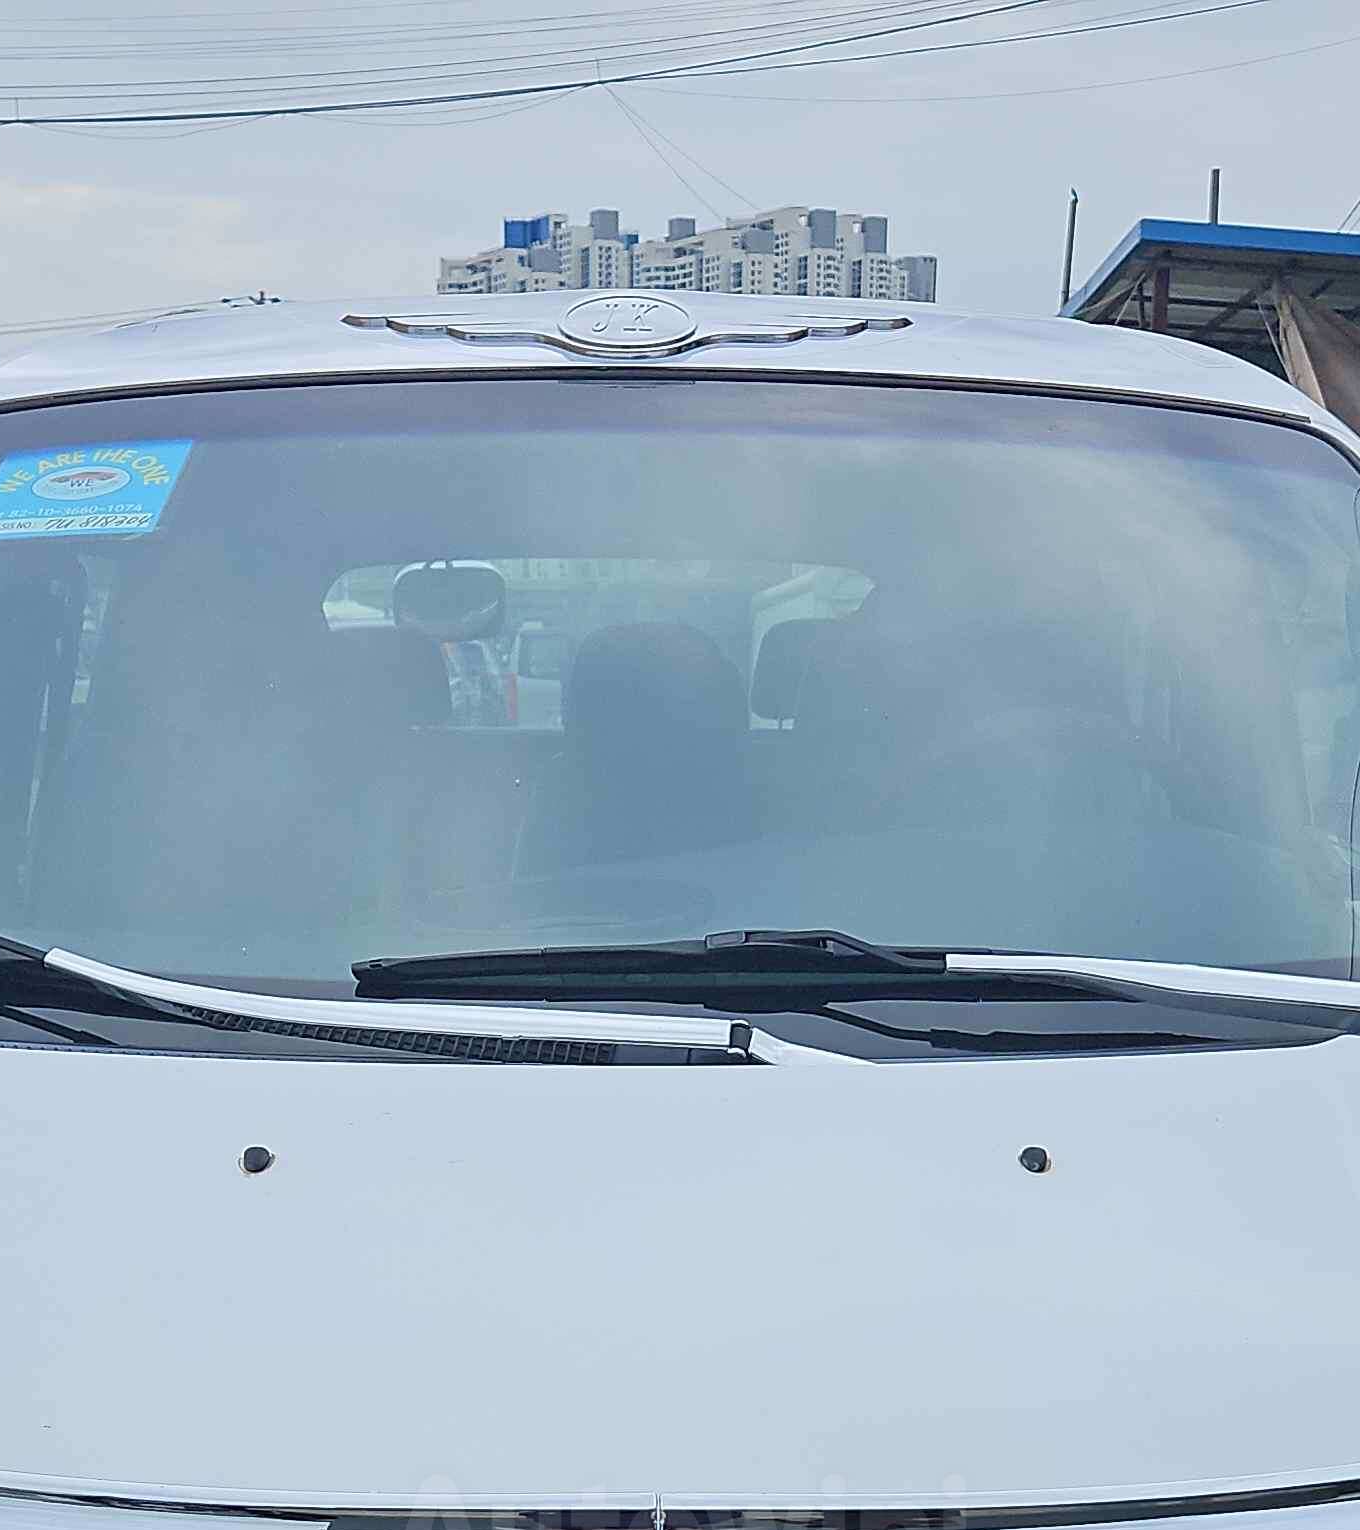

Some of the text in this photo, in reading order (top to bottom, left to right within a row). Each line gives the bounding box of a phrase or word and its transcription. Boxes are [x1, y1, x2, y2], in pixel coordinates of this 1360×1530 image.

[38, 451, 86, 474] ARE
[93, 447, 138, 465] THE
[131, 455, 171, 487] ONE
